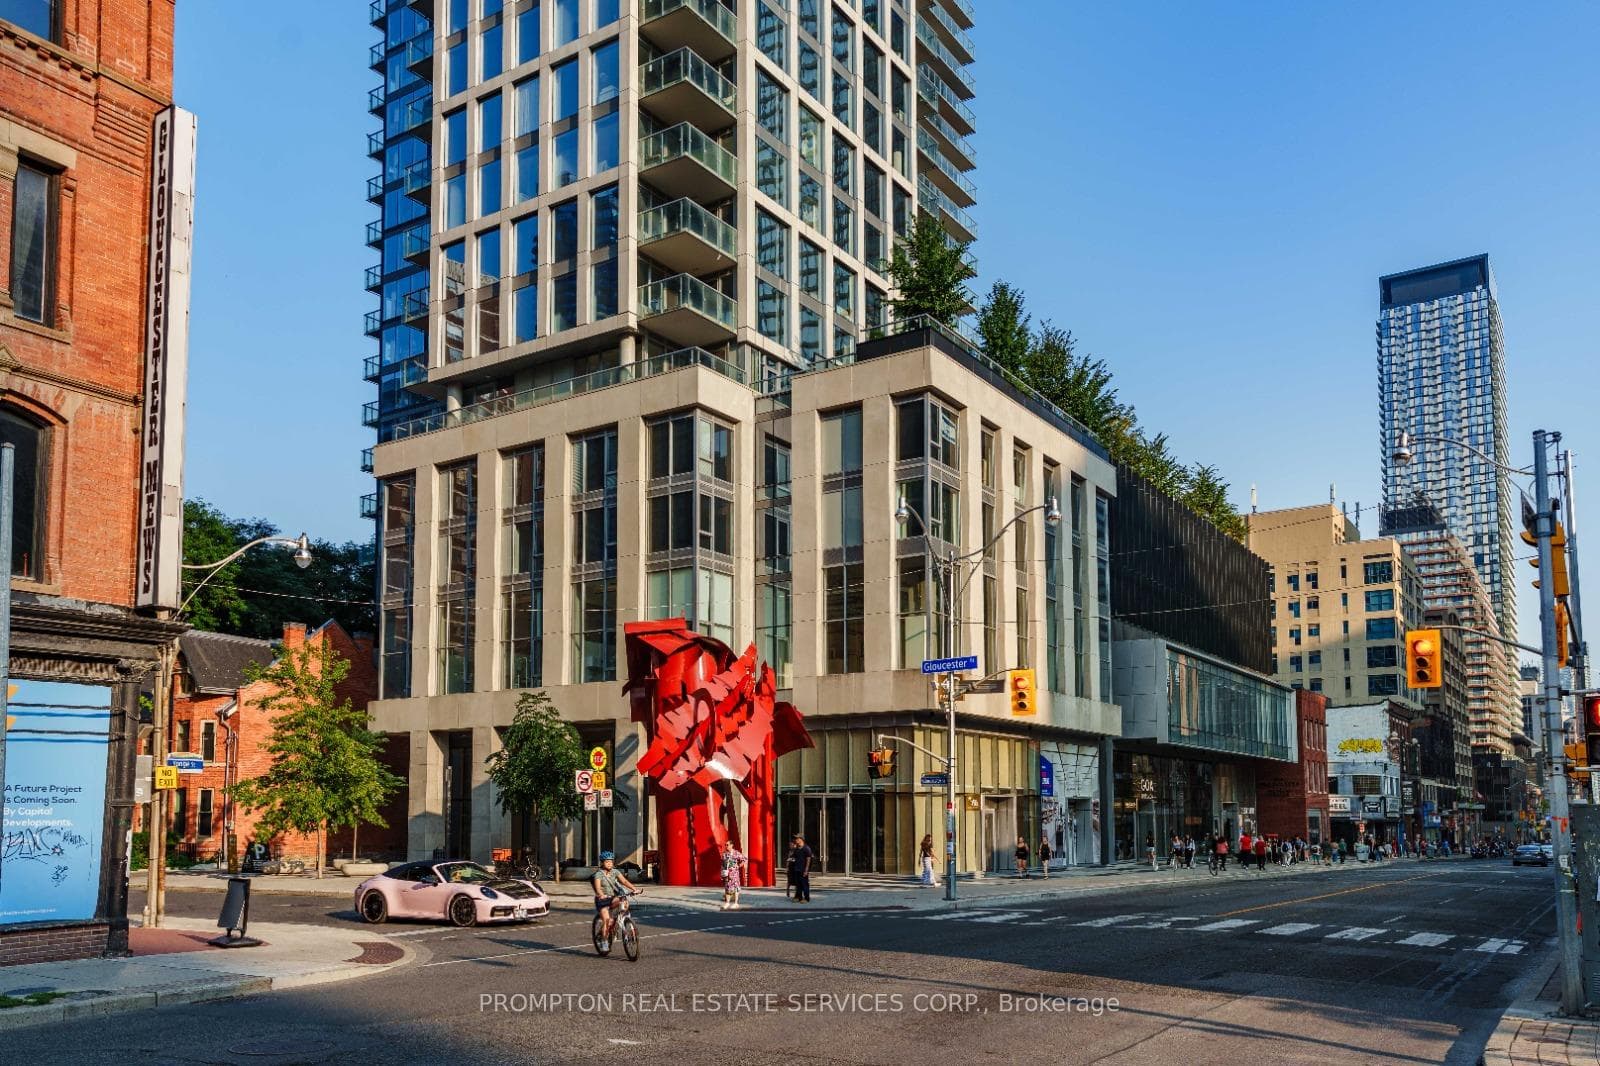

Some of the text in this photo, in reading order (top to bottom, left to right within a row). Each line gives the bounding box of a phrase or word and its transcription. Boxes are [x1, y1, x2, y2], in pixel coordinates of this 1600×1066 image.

[142, 119, 168, 595] GLOUCESTER MEWS
[923, 659, 968, 672] Gloucester
[161, 769, 172, 777] NO
[159, 778, 174, 787] EXIT
[1140, 779, 1154, 791] GOA
[14, 784, 48, 793] Future
[49, 784, 82, 796] Project
[13, 795, 50, 807] Coming
[51, 796, 78, 804] Soon.
[3, 807, 54, 818] By Capital
[2, 818, 74, 828] Developments.
